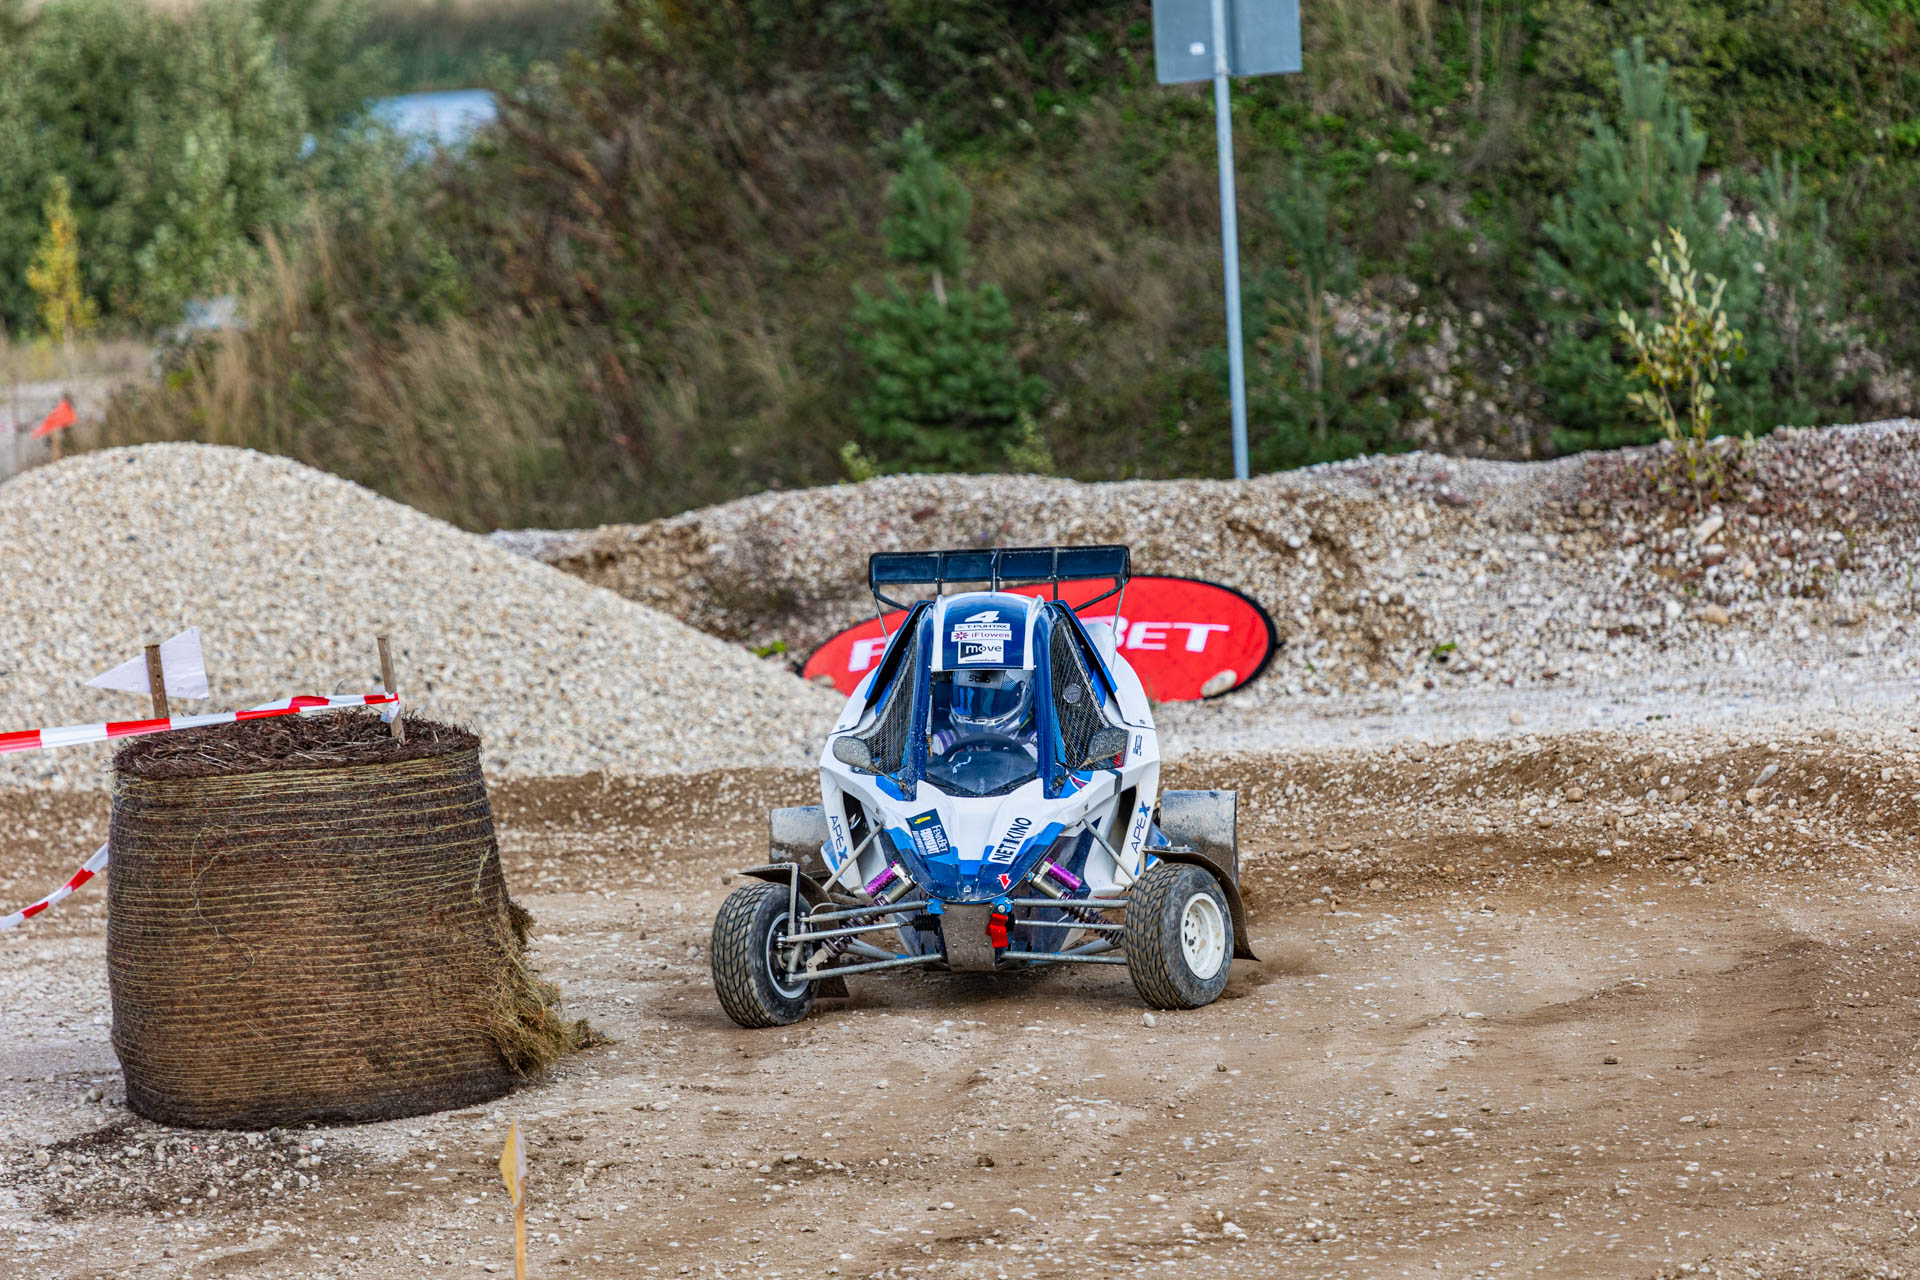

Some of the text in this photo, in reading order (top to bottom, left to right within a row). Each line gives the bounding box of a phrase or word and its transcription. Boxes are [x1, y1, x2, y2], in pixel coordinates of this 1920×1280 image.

[964, 610, 1000, 623] 4
[966, 644, 1002, 654] move
[829, 816, 849, 865] APEX
[1131, 800, 1151, 854] APEX
